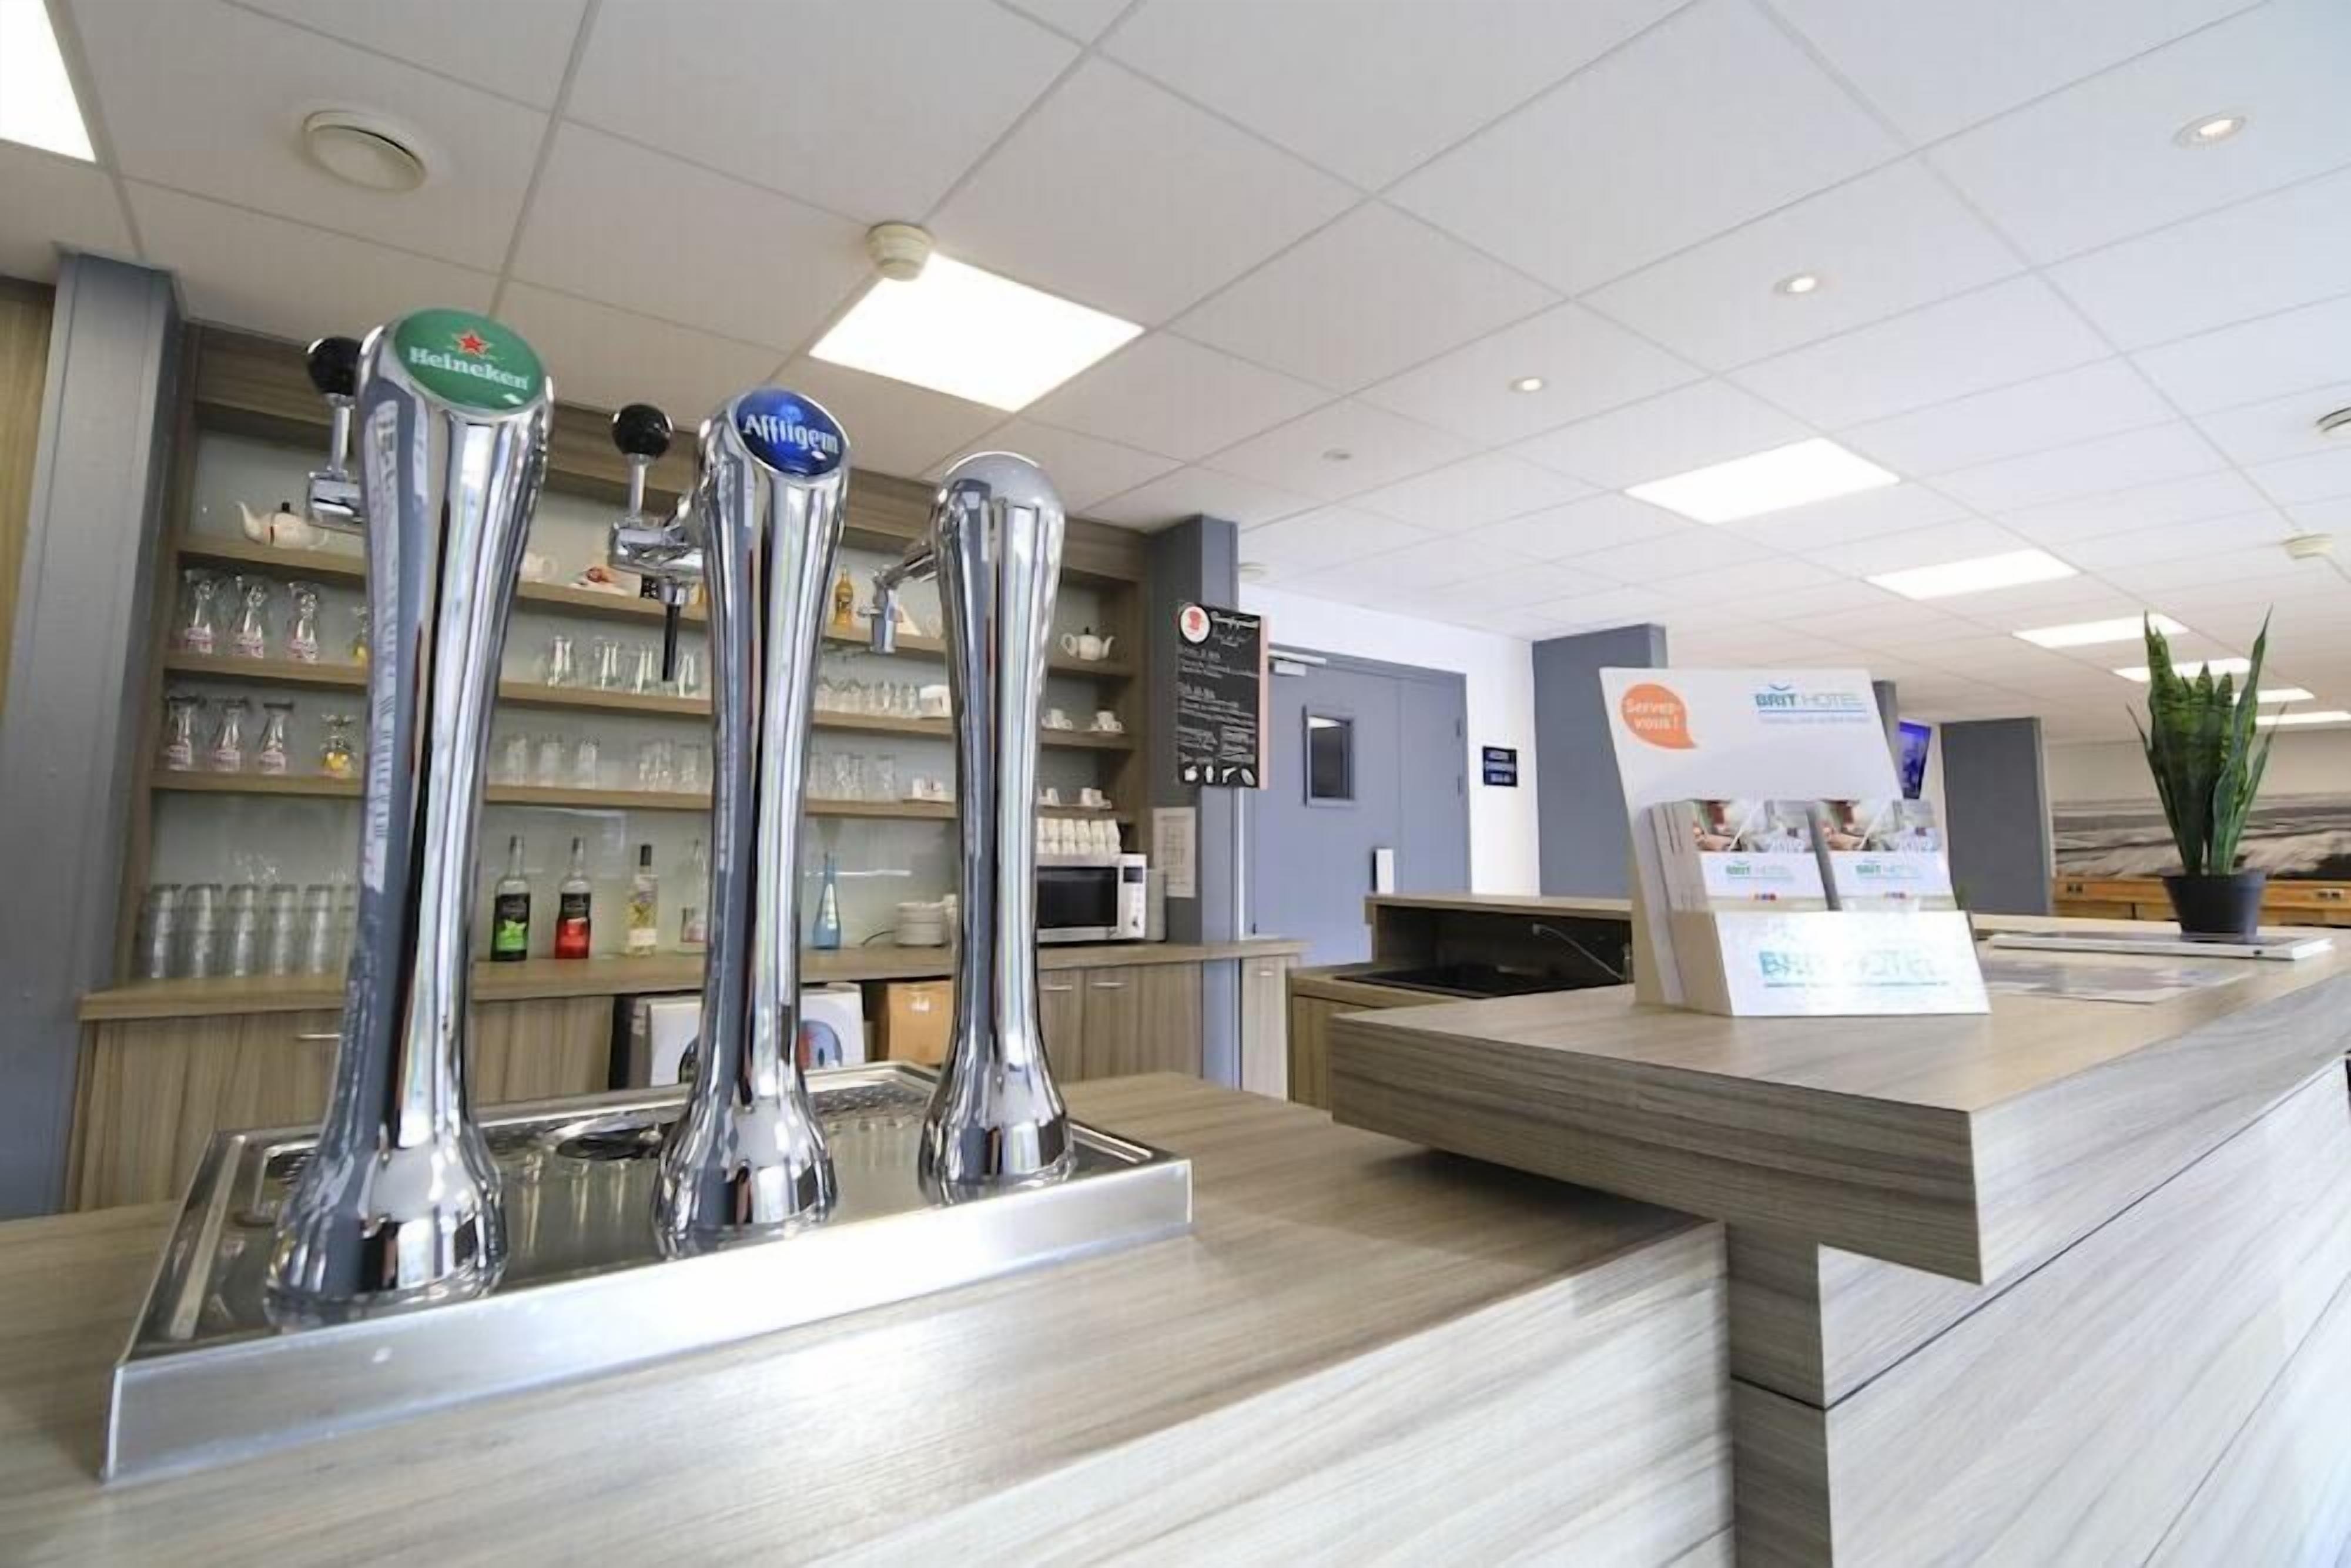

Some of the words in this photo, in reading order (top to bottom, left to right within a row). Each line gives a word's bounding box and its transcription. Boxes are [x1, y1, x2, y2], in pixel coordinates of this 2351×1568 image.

[410, 347, 530, 390] Heineken
[743, 413, 839, 454] Affligem
[1755, 693, 1796, 707] BRIT
